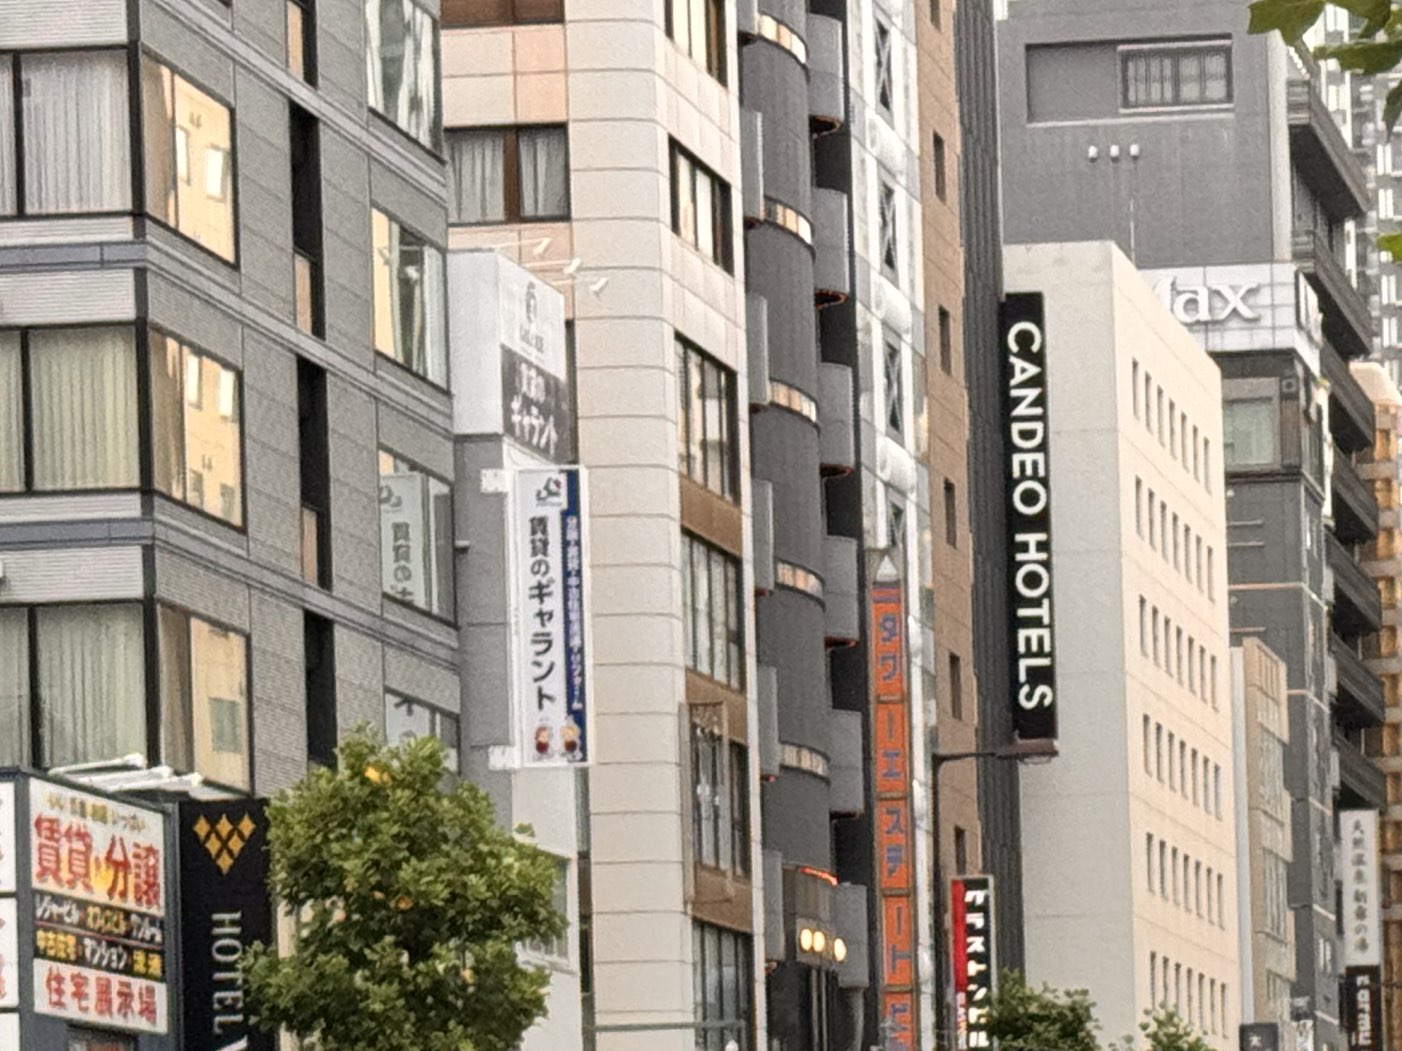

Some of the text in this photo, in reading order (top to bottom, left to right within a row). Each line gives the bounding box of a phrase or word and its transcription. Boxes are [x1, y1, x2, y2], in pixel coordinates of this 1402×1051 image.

[1007, 321, 1053, 710] CANDEO HOTELS
[211, 910, 245, 1035] HOTEL
